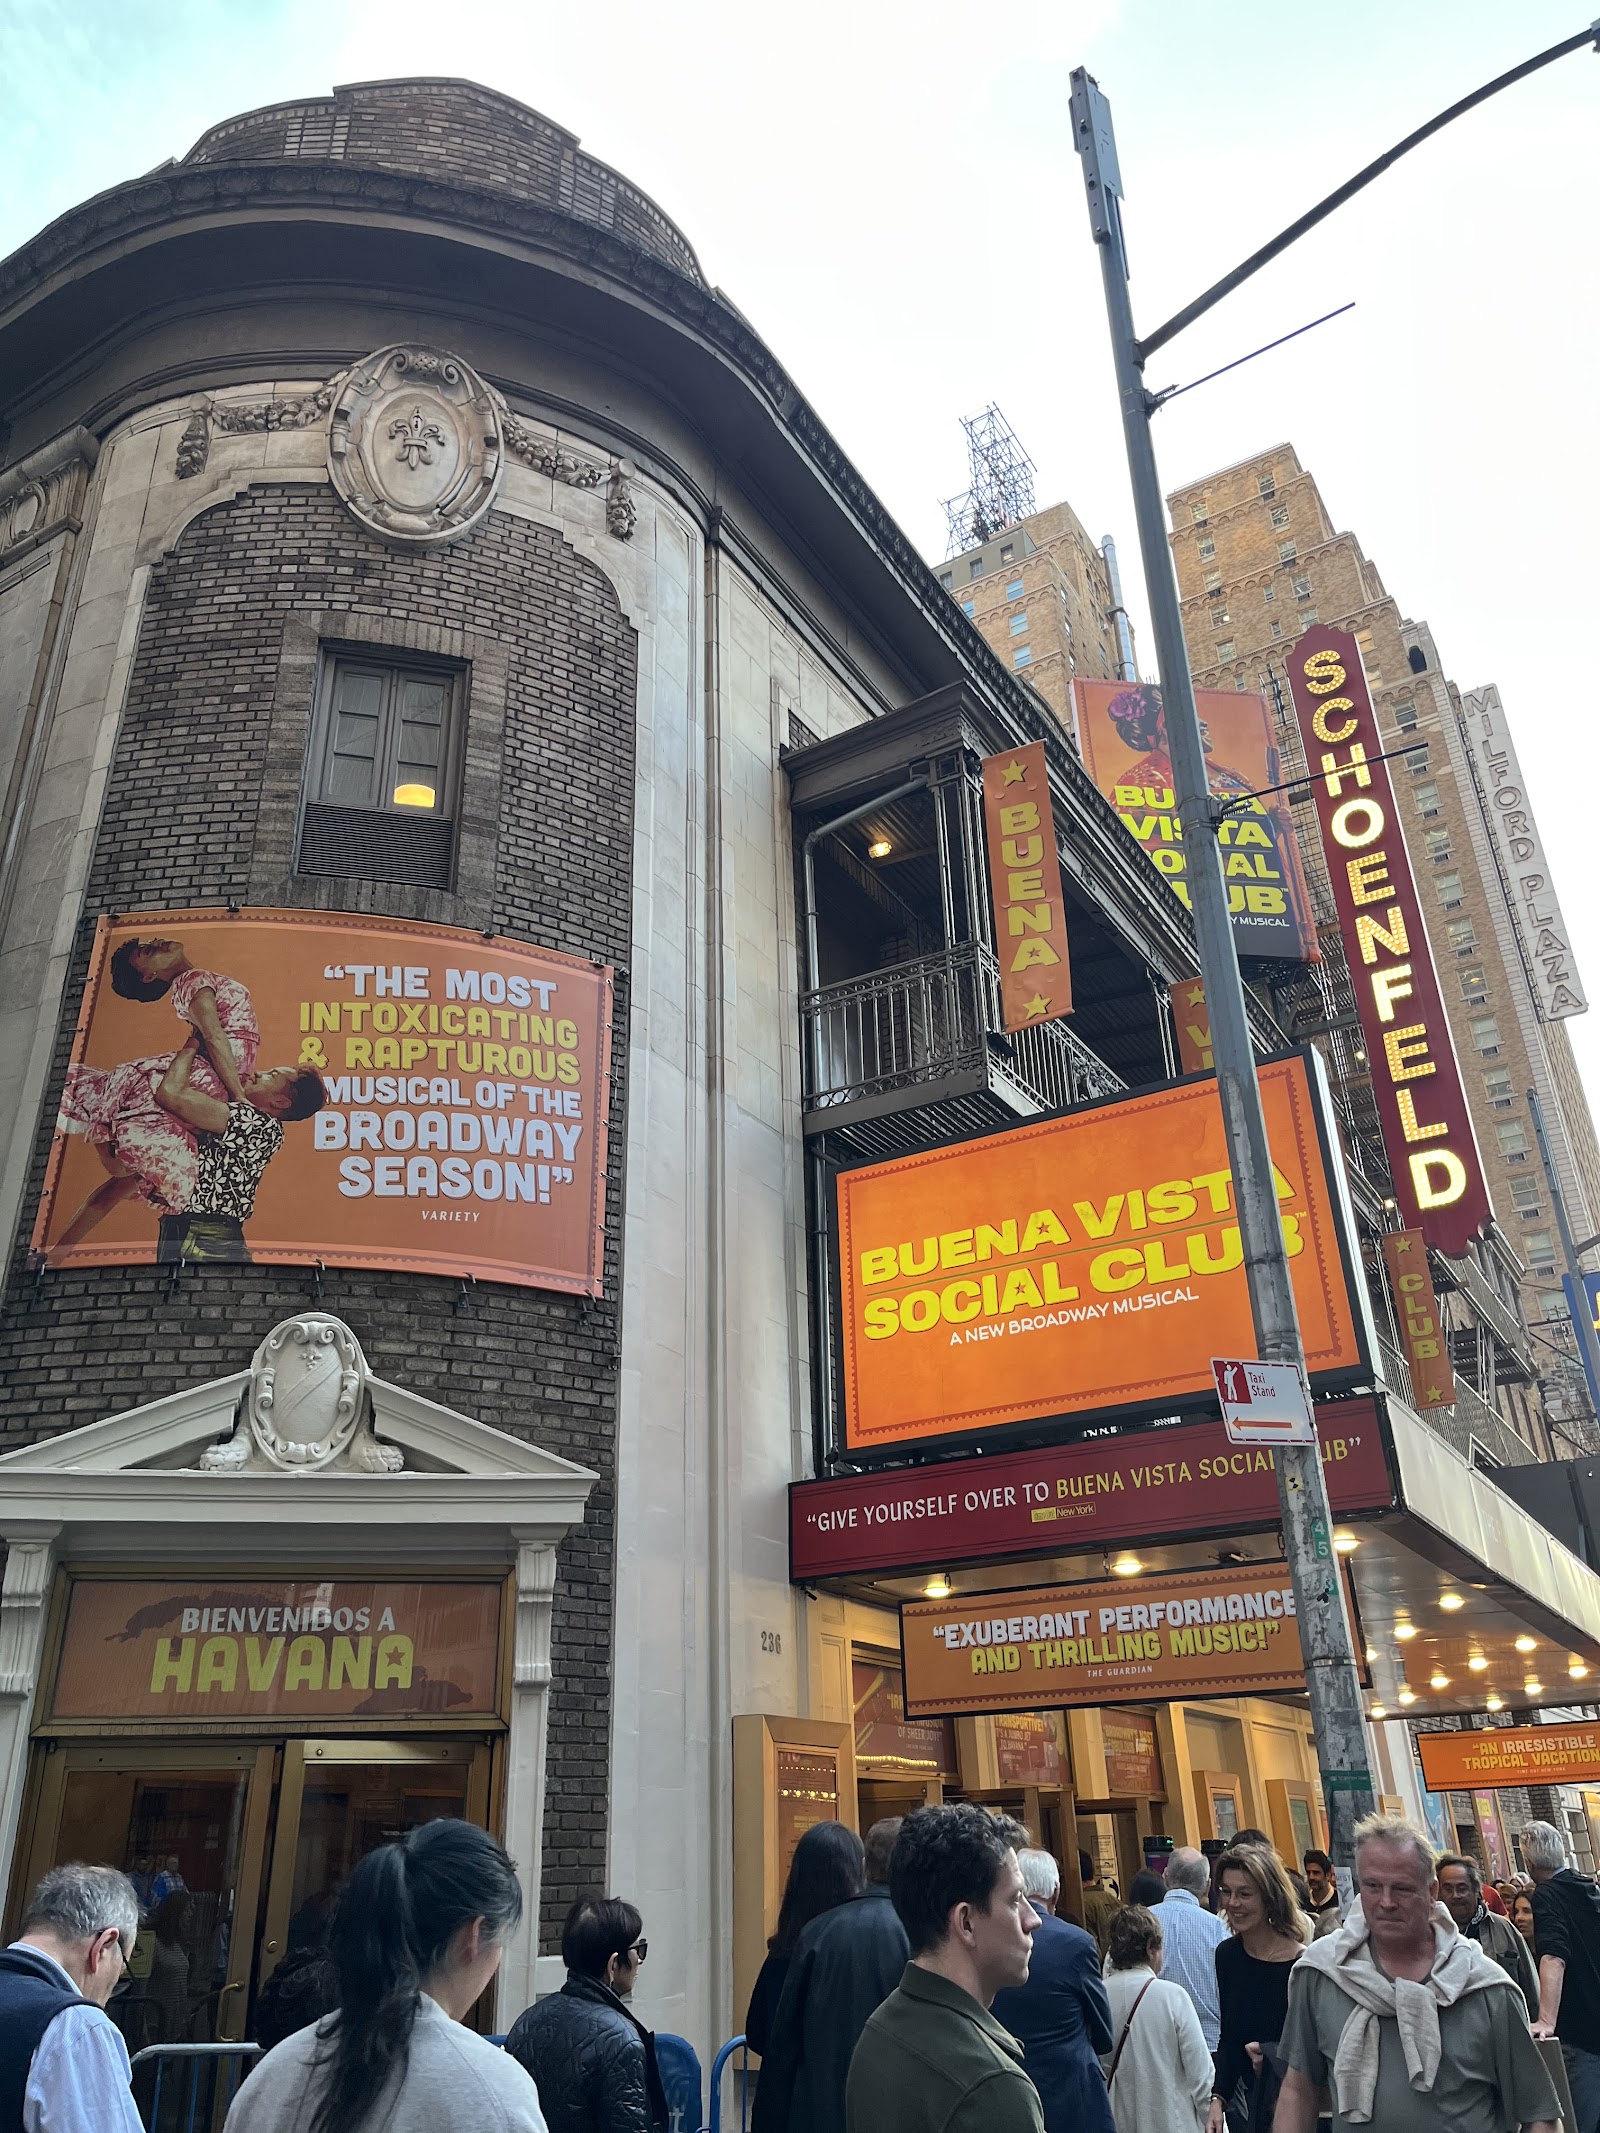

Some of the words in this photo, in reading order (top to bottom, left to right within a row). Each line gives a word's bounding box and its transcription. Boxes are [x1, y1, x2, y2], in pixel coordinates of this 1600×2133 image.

[1464, 689, 1536, 864] MILFORD
[1522, 872, 1584, 1015] PLAZA
[1000, 801, 1060, 973] BUENA
[1240, 917, 1290, 927] MUSICAL
[1304, 649, 1466, 1209] SCHOENFELD
[324, 965, 430, 999] “THE
[446, 969, 558, 1012] MOST
[300, 1002, 580, 1050] INTOXICATING
[298, 1037, 328, 1068] &
[345, 1038, 582, 1085] RAPTUROUS
[324, 1076, 471, 1108] MUSICAL
[475, 1080, 515, 1109] OF
[521, 1085, 583, 1119] THE
[314, 1111, 584, 1161] BROADWAY
[338, 1156, 574, 1204] SEASON!”
[421, 1210, 482, 1223] VARIETY
[860, 1210, 1070, 1287] BUENA
[864, 1261, 1079, 1341] SOCIAL
[949, 1332, 963, 1347] A
[965, 1322, 1005, 1343] NEW
[1008, 1305, 1110, 1335] BROADWAY
[1112, 1287, 1200, 1314] MUSICAL
[1399, 1273, 1442, 1360] CLUB
[1248, 1371, 1266, 1385] Taxi
[1251, 1382, 1276, 1399] Stand
[807, 1508, 858, 1533] “GIVE
[863, 1494, 958, 1526] YOURSELF
[964, 1485, 1017, 1512] OVER
[1022, 1481, 1049, 1504] TO
[1056, 1471, 1125, 1498] BUENA
[1130, 1461, 1192, 1488] VISTA
[1320, 1437, 1361, 1462] UB”
[1056, 1507, 1075, 1518] New
[1076, 1504, 1094, 1515] York
[181, 1606, 371, 1634] BIENVENIDOS
[377, 1606, 396, 1631] A
[761, 1631, 781, 1655] 236
[932, 1608, 1090, 1650] “EXUBERANT
[150, 1634, 414, 1695] HAVANA
[972, 1643, 1021, 1675] AND
[1028, 1629, 1161, 1670] THRILLING
[1171, 1621, 1280, 1658] MUSIC!”
[1087, 1668, 1104, 1679] THE
[1107, 1664, 1153, 1677] GUARDIAN
[1462, 1755, 1529, 1770] TROPICAL
[1532, 1748, 1600, 1767] VACATION
[1473, 1741, 1499, 1756] “AN
[1503, 1735, 1597, 1754] IRRESISTIBLE
